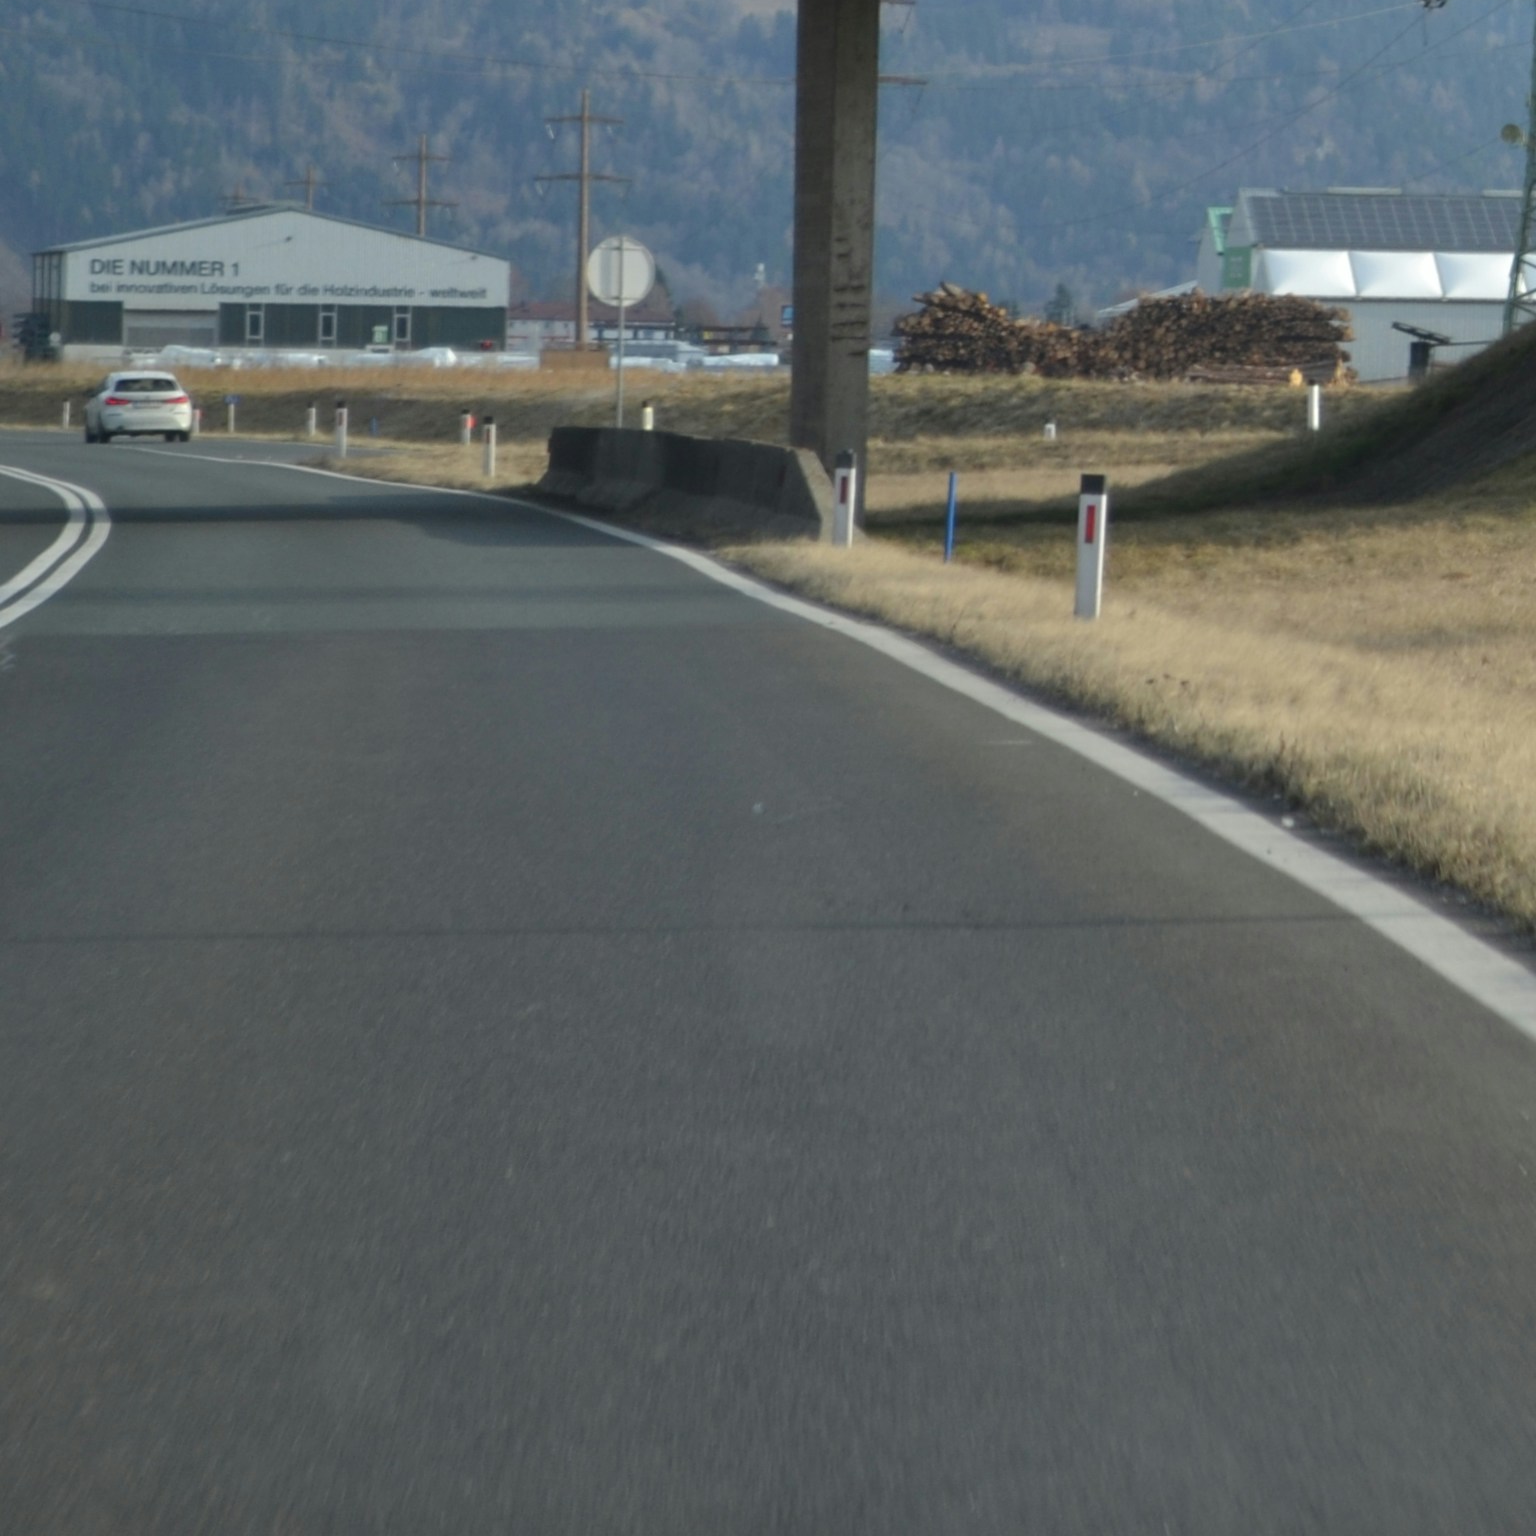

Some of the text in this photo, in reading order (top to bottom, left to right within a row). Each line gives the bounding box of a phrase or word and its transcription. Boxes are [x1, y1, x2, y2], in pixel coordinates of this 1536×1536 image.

[90, 259, 239, 276] DIE NUMMER 1
[90, 282, 112, 293] bei
[116, 282, 198, 294] innovativen
[201, 282, 270, 297] Lösungen
[274, 283, 292, 295] für
[297, 284, 319, 296] die
